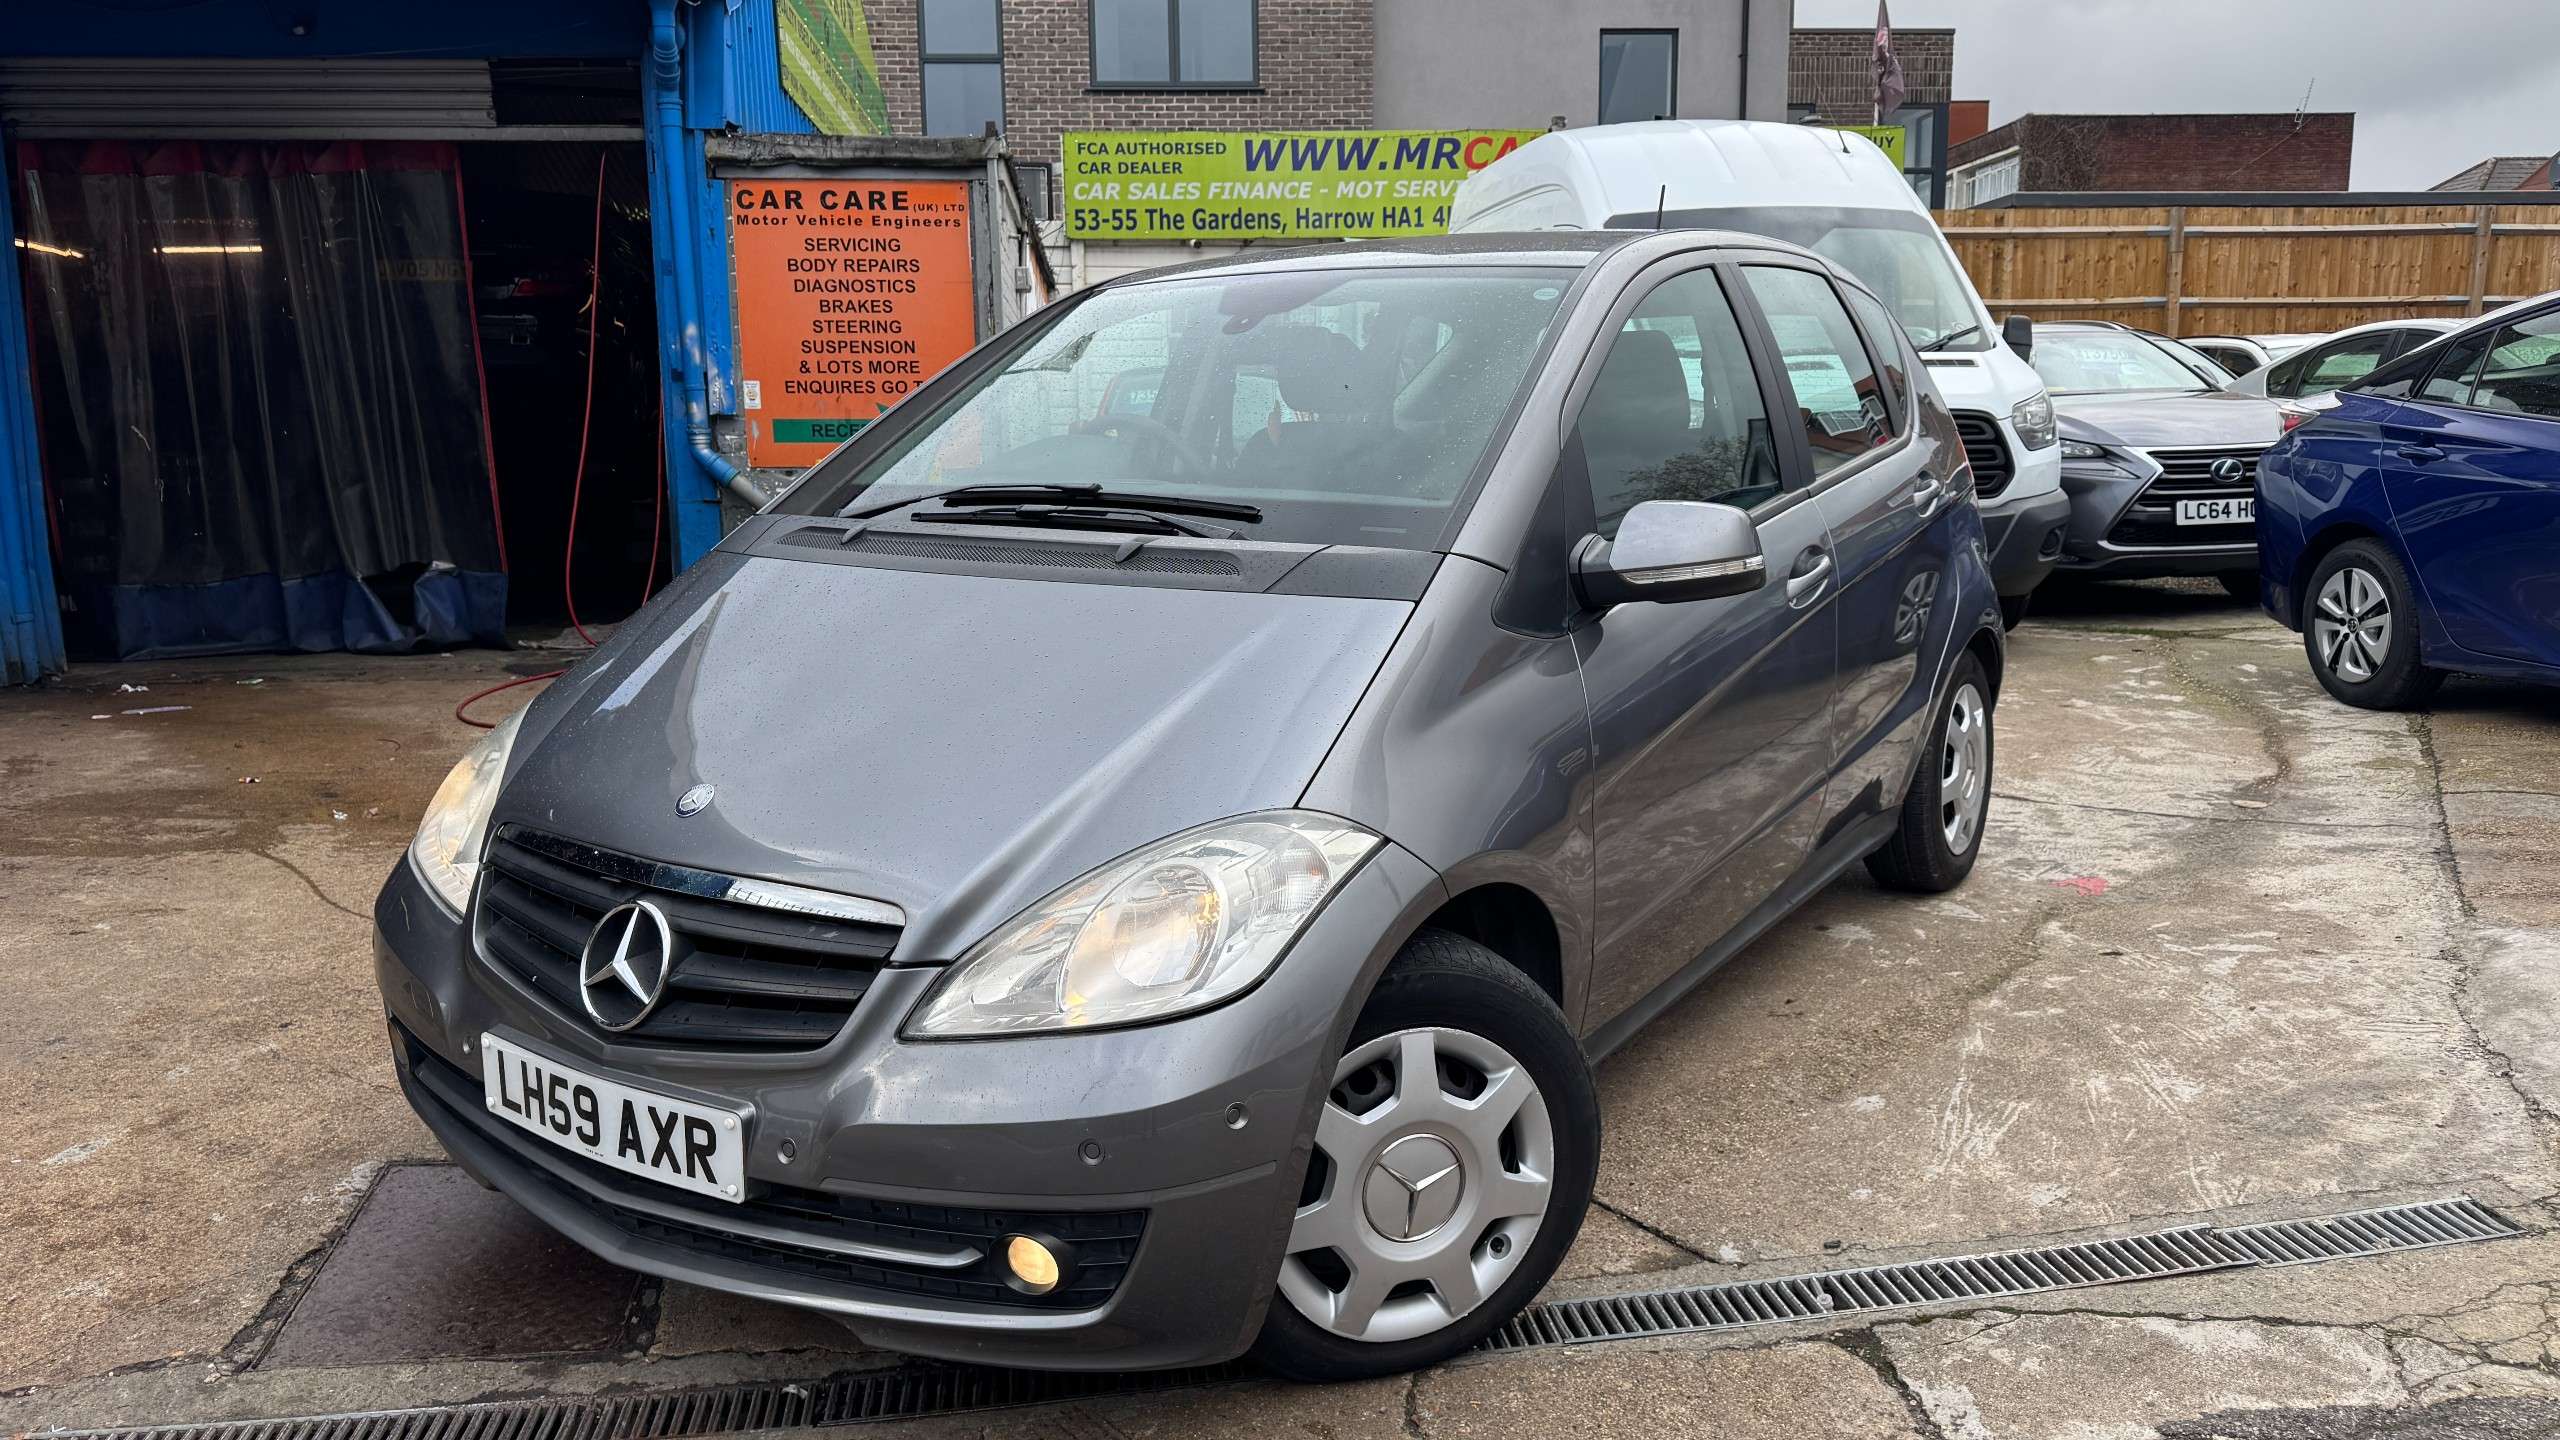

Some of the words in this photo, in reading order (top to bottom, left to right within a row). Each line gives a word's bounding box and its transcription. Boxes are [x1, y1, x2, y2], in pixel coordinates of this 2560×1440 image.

[1077, 142, 1109, 155] FCA
[1115, 142, 1227, 155] AUTHORISED
[1245, 136, 1520, 171] WWW.MRCA
[1078, 162, 1111, 174] CAR
[1118, 162, 1183, 174] DEALER
[1073, 182, 1120, 200] CAR
[1128, 181, 1201, 200] SALES
[1208, 181, 1313, 200] FINANCE
[1337, 181, 1388, 198] MOT
[737, 189, 803, 210] CAR
[820, 190, 909, 211] CARE
[913, 203, 938, 212] (UK)
[944, 204, 965, 212] LTD
[737, 215, 788, 226] Motor
[796, 215, 863, 227] Vehicle
[872, 216, 961, 229] Engineers
[1074, 208, 1137, 231] 53-55
[1145, 207, 1185, 230] The
[1192, 206, 1287, 234] Gardens,
[1296, 207, 1374, 229] Harrow
[1383, 206, 1424, 228] HA1
[804, 238, 901, 252] SERVICING
[787, 258, 837, 272] BODY
[844, 258, 920, 273] REPAIRS
[794, 279, 916, 293] DIAGNOSTICS
[819, 299, 893, 314] BRAKES
[812, 320, 902, 334] STEERING
[801, 340, 916, 354] SUSPENSION
[799, 360, 811, 374] &
[816, 360, 863, 374] LOTS
[868, 360, 920, 374] MORE
[785, 380, 876, 394] ENQUIRES
[881, 380, 908, 394] GO
[811, 423, 865, 438] RECE
[2184, 501, 2232, 520] LC64
[497, 1050, 601, 1148] LH59
[617, 1099, 718, 1185] AXR
